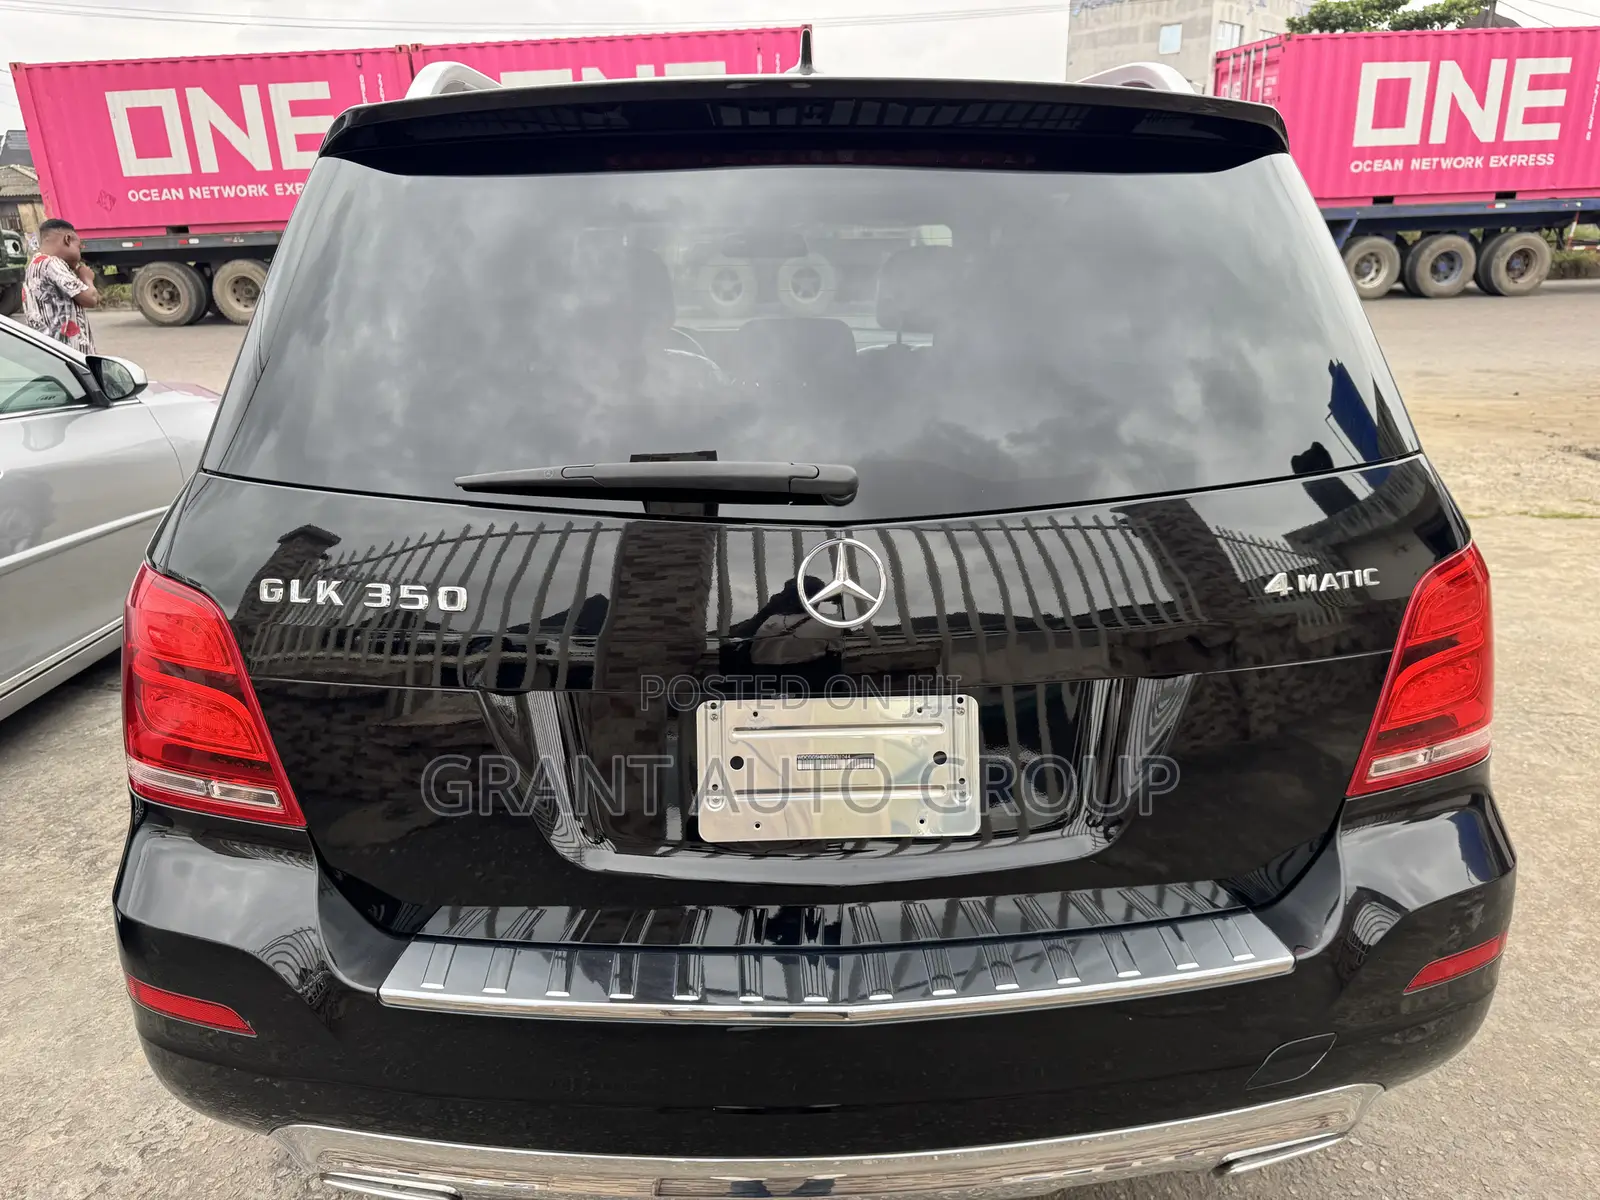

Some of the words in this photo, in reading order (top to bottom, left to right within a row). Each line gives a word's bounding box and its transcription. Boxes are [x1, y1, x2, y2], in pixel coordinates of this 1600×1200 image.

[1352, 57, 1573, 147] ONE
[104, 81, 335, 177] ONE
[1350, 159, 1404, 173] OCEAN
[1410, 156, 1484, 171] NETWORK
[1489, 153, 1555, 168] EXPRESS
[127, 187, 184, 202] OCEAN
[188, 184, 269, 199] NETWORK
[259, 578, 344, 606] GLK
[363, 583, 468, 612] 350
